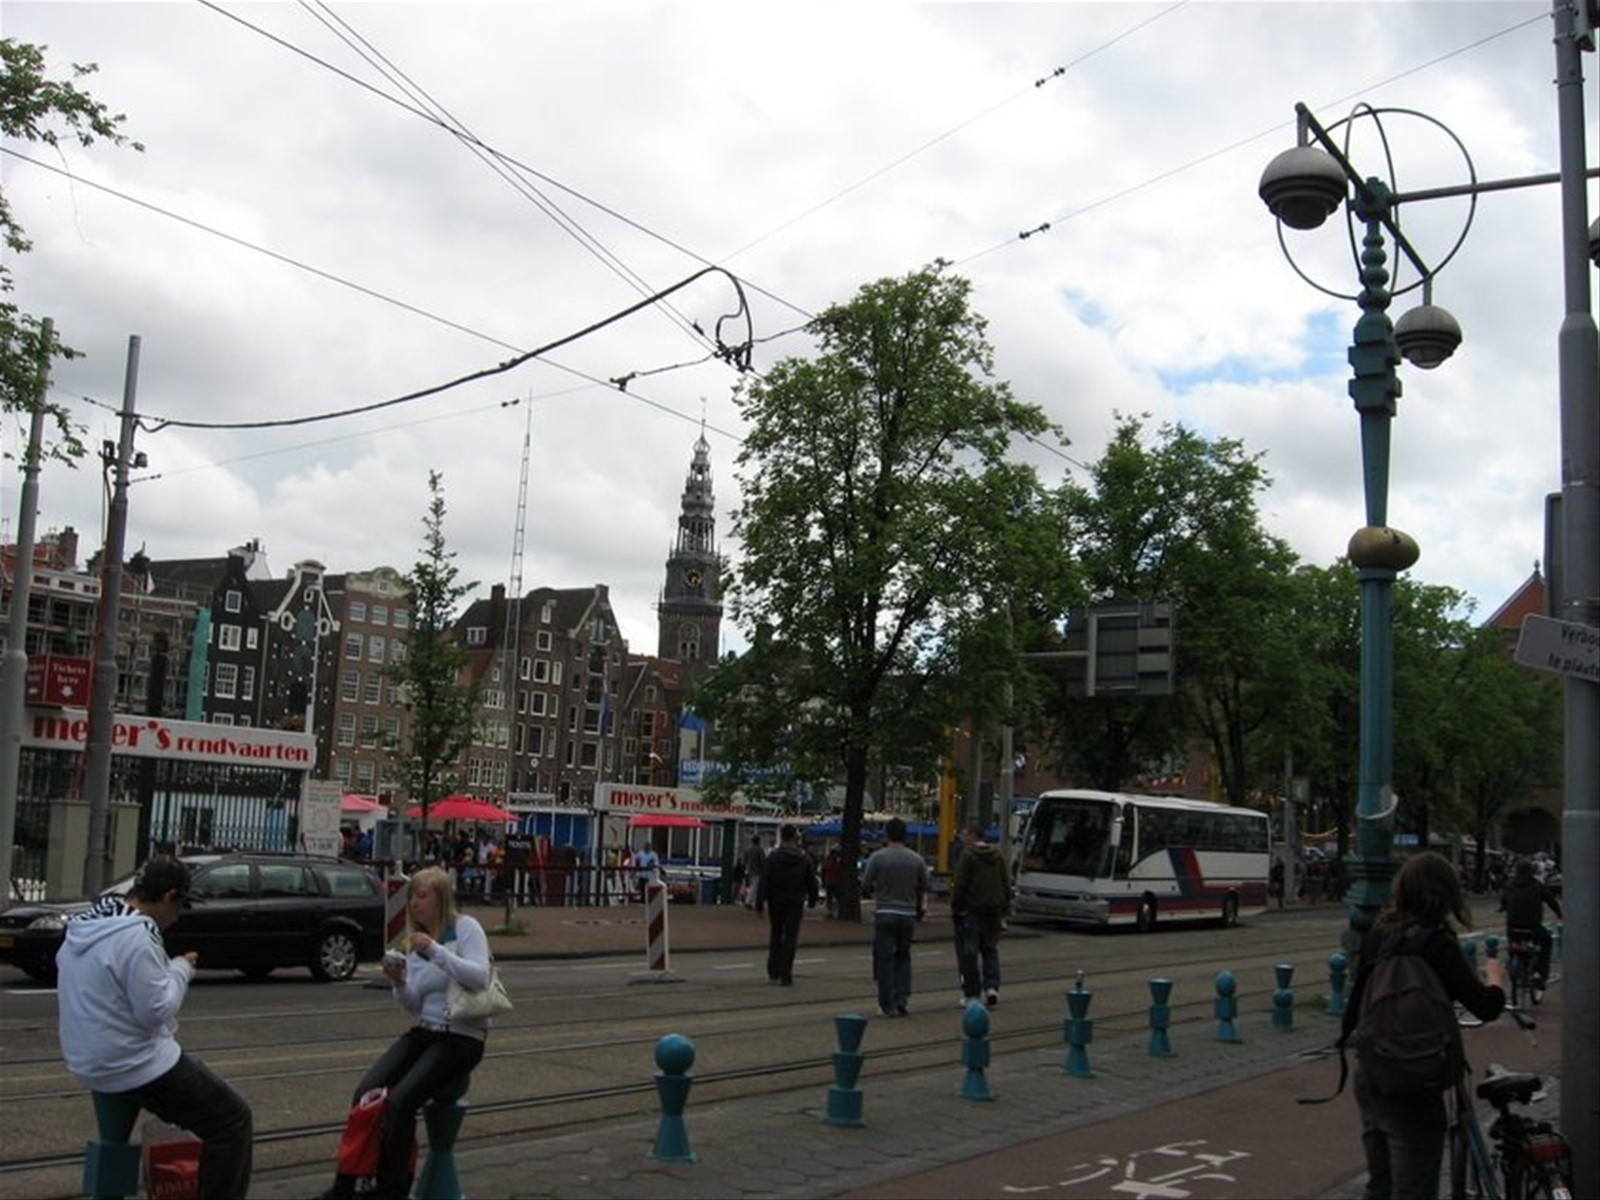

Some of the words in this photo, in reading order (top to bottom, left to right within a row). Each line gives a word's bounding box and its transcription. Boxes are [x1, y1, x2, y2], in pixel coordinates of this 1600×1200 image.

[53, 663, 86, 675] Tickets
[33, 715, 170, 750] meer's
[176, 736, 309, 762] rondvaarten
[610, 789, 677, 809] meyer's
